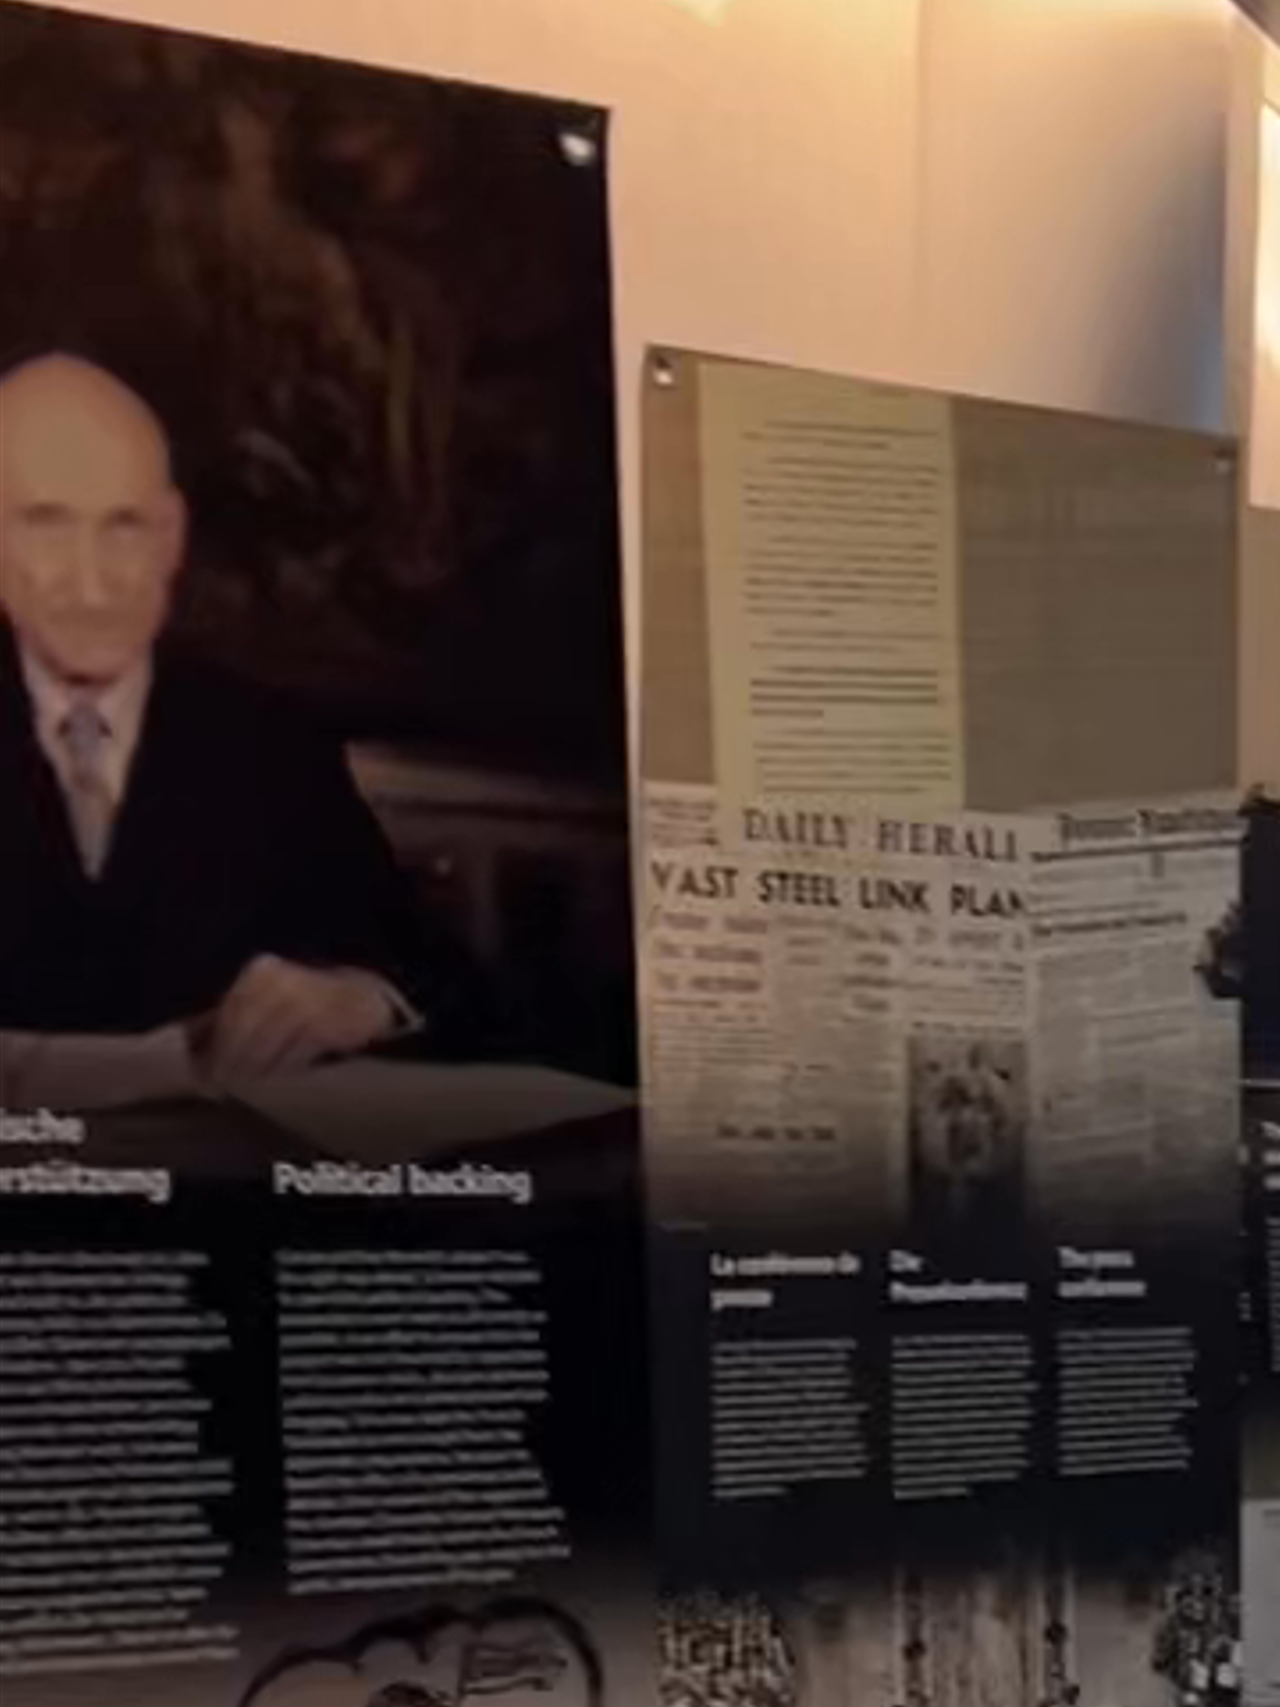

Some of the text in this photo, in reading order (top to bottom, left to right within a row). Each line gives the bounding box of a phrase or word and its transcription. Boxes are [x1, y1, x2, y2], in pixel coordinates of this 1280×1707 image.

[741, 808, 850, 849] DAILY
[650, 861, 739, 899] VAST
[757, 870, 841, 908] STEEL
[858, 877, 932, 914] LINK
[273, 1160, 532, 1205] Political backing
